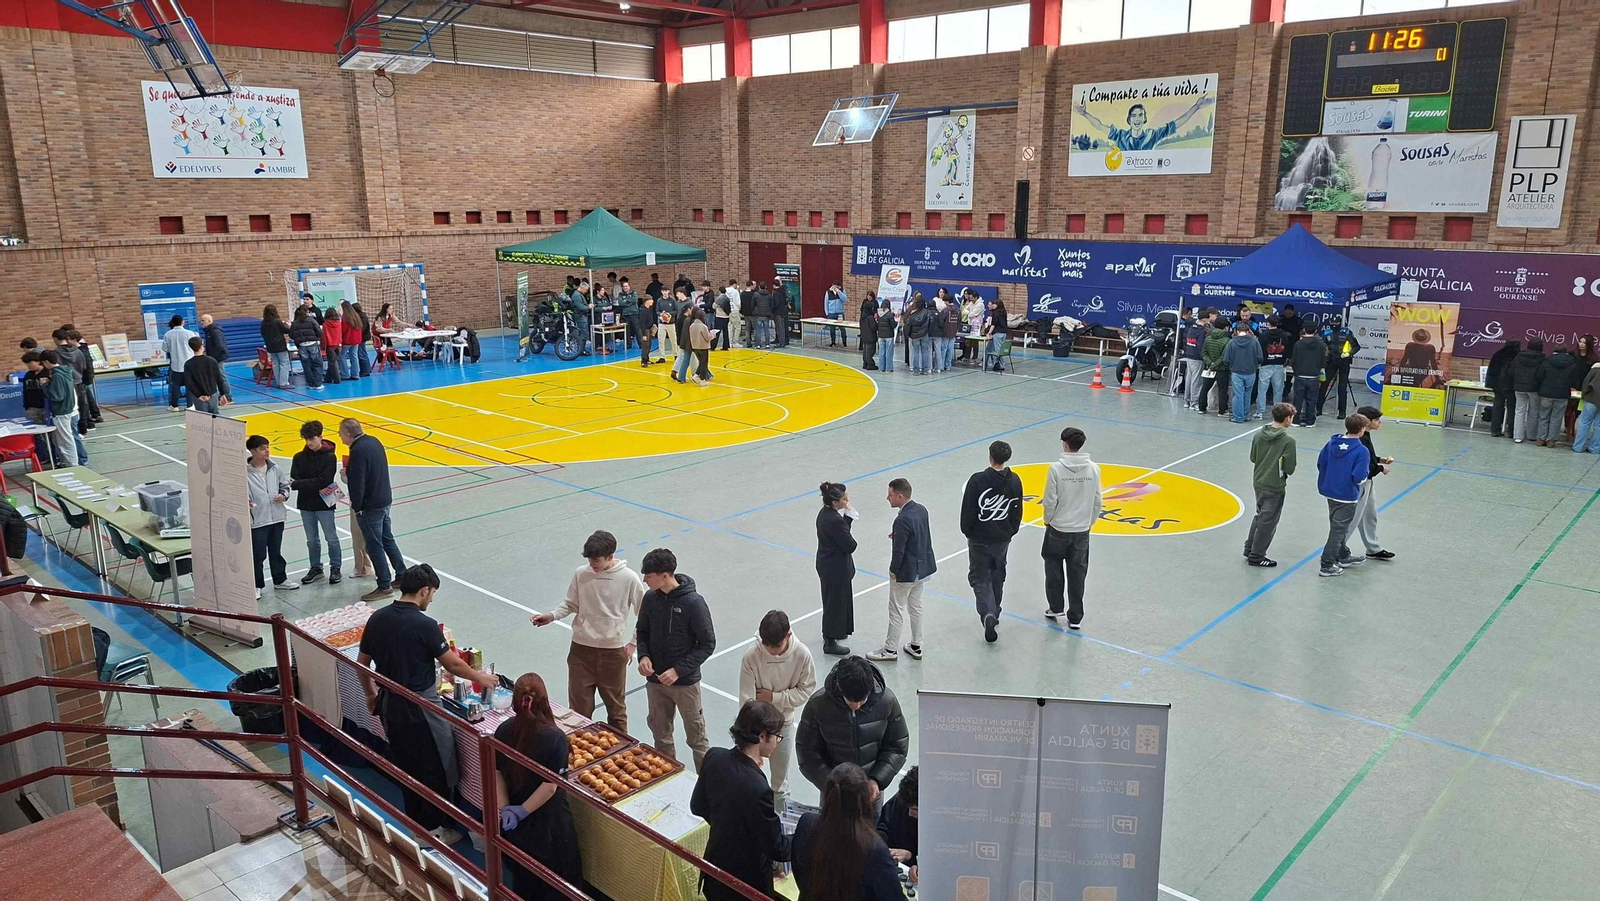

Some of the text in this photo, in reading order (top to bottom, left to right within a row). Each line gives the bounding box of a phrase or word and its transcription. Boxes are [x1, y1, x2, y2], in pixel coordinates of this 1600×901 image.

[1368, 28, 1423, 51] 11:26
[1088, 86, 1138, 105] Comparte
[1141, 88, 1148, 98] a
[1152, 81, 1170, 98] túa
[1174, 79, 1199, 96] vida
[1373, 85, 1398, 93] Bodet
[148, 86, 160, 102] Se
[257, 94, 264, 102] a
[265, 93, 296, 107] xustiza
[1327, 104, 1374, 127] SOUSAS
[1408, 109, 1448, 118] TURINI
[1400, 142, 1488, 164] SOUSAS Maristas
[179, 164, 298, 174] EDELVIVES TAMBRE
[1509, 172, 1559, 193] PLP
[1507, 193, 1556, 203] ATELIER
[868, 247, 892, 256] XUNTA
[1057, 248, 1091, 261] Xuntos
[868, 255, 905, 265] DE GALICIA
[960, 252, 996, 268] OCHO
[1060, 260, 1087, 269] somos
[1001, 265, 1049, 279] maristas
[1062, 269, 1084, 279] mais
[1401, 266, 1446, 278] XUNTA
[1420, 279, 1474, 292] GALICIA
[1493, 285, 1547, 295] DEPUTACIÓN
[1204, 289, 1236, 297] OURENSE
[1255, 287, 1328, 299] POLICÍA LOCAL
[1499, 293, 1538, 301] OURENSE
[1117, 300, 1143, 313] Silvia
[1397, 307, 1453, 324] WOW
[1525, 328, 1565, 344] Silvia
[0, 391, 22, 400] Deusto
